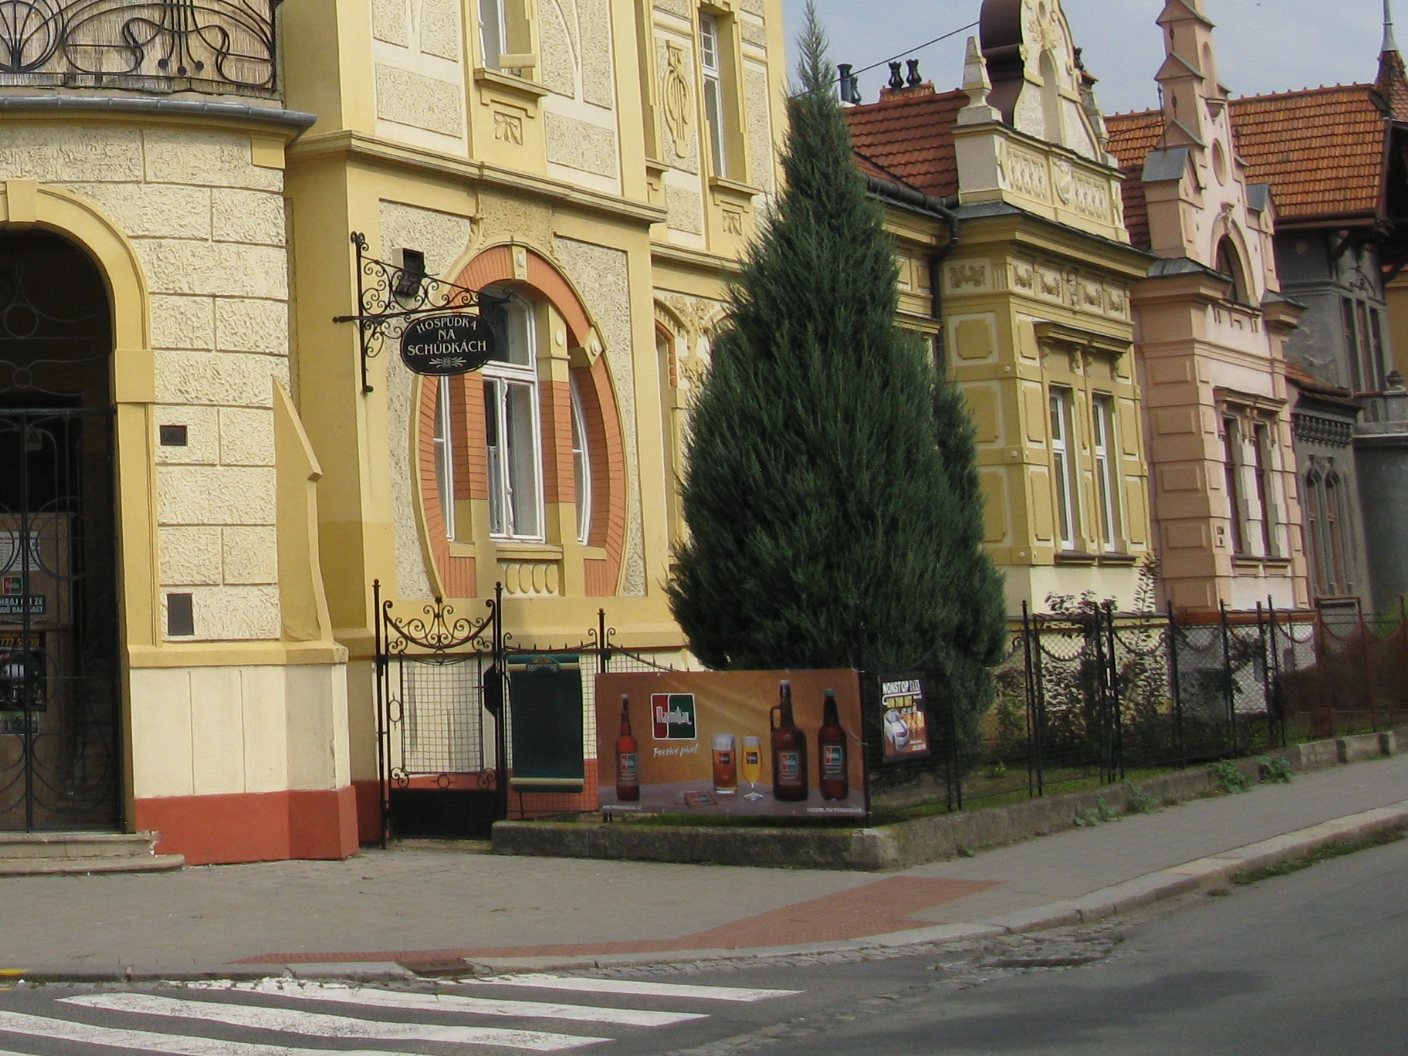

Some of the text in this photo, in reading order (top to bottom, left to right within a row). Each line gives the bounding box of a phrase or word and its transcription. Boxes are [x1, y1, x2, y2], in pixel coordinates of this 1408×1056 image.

[437, 329, 456, 340] NA
[0, 637, 14, 646] 777
[882, 680, 909, 694] NONSTOP
